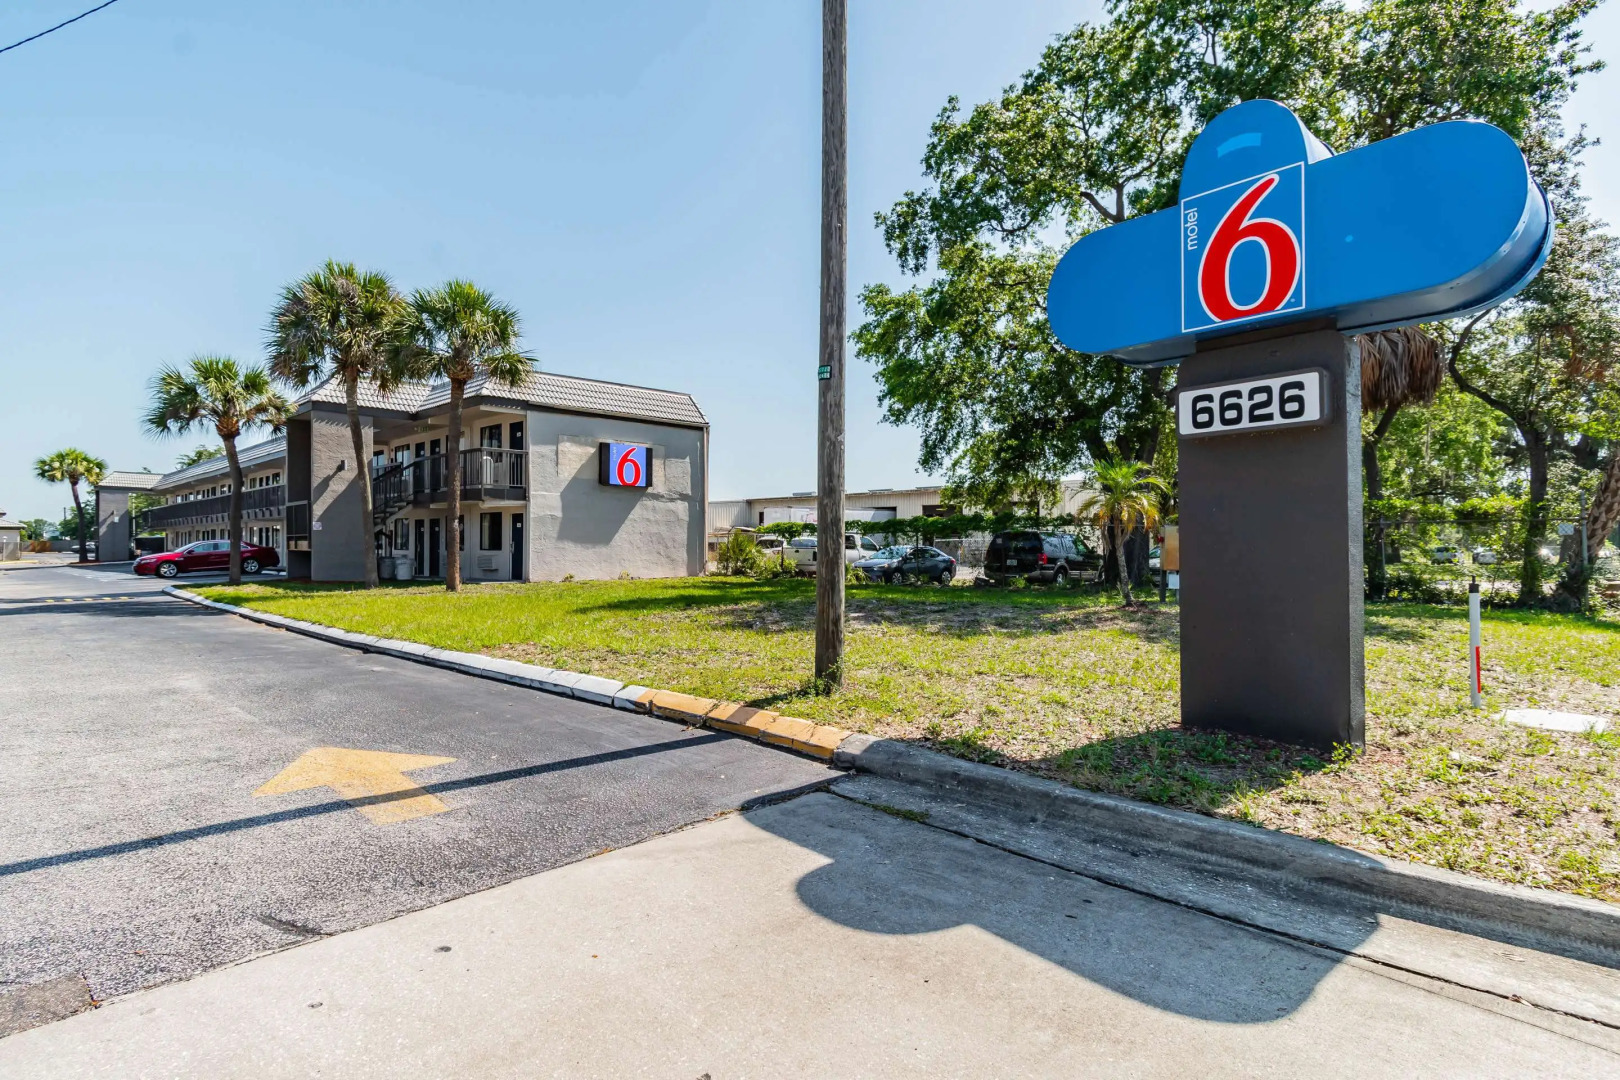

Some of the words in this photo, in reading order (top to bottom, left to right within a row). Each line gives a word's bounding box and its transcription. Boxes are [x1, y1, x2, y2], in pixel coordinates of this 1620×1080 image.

[1185, 207, 1198, 251] motel
[1198, 173, 1301, 322] 6
[1191, 380, 1305, 430] 6626
[616, 446, 642, 486] 6
